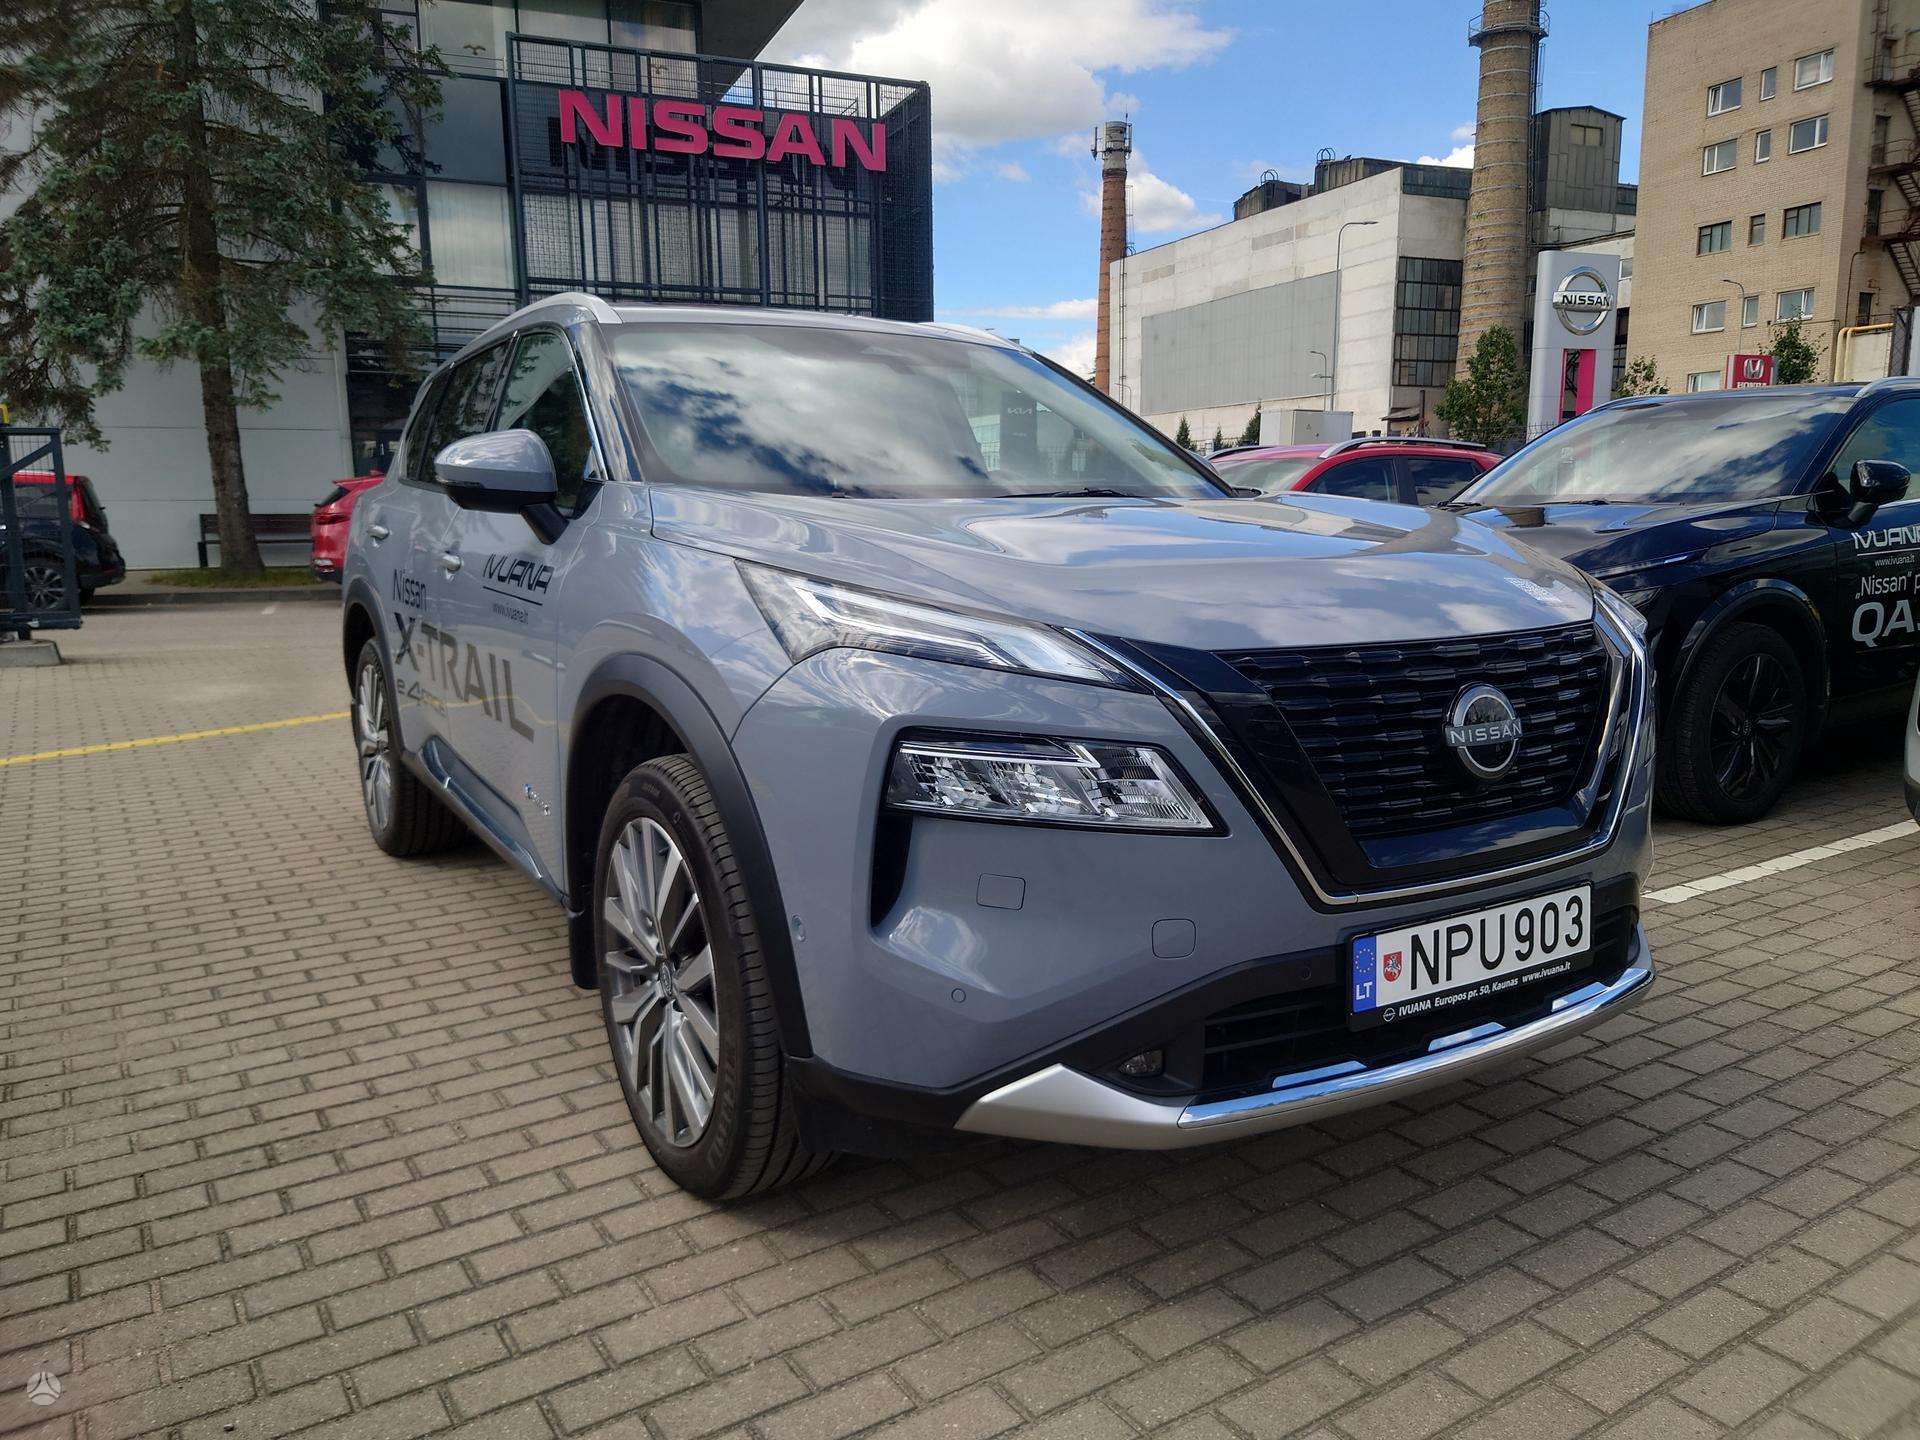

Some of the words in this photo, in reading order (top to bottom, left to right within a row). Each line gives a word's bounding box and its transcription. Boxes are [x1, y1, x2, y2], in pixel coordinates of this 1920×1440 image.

[558, 88, 888, 172] NISSAN
[1562, 294, 1610, 307] NISSAN
[1851, 526, 1920, 549] IVUAN
[393, 569, 427, 612] Nissan
[1852, 600, 1920, 647] QA
[394, 612, 535, 744] X-TRAIL
[1450, 723, 1521, 744] NISSAN
[1410, 895, 1584, 991] NPU903
[1356, 981, 1373, 1000] LT
[1399, 999, 1431, 1017] IVUANA
[1434, 991, 1467, 1007] Europos
[1467, 990, 1478, 1000] pr.
[1491, 977, 1518, 991] Kaunas
[1522, 961, 1571, 983] www.ivuana.lt
